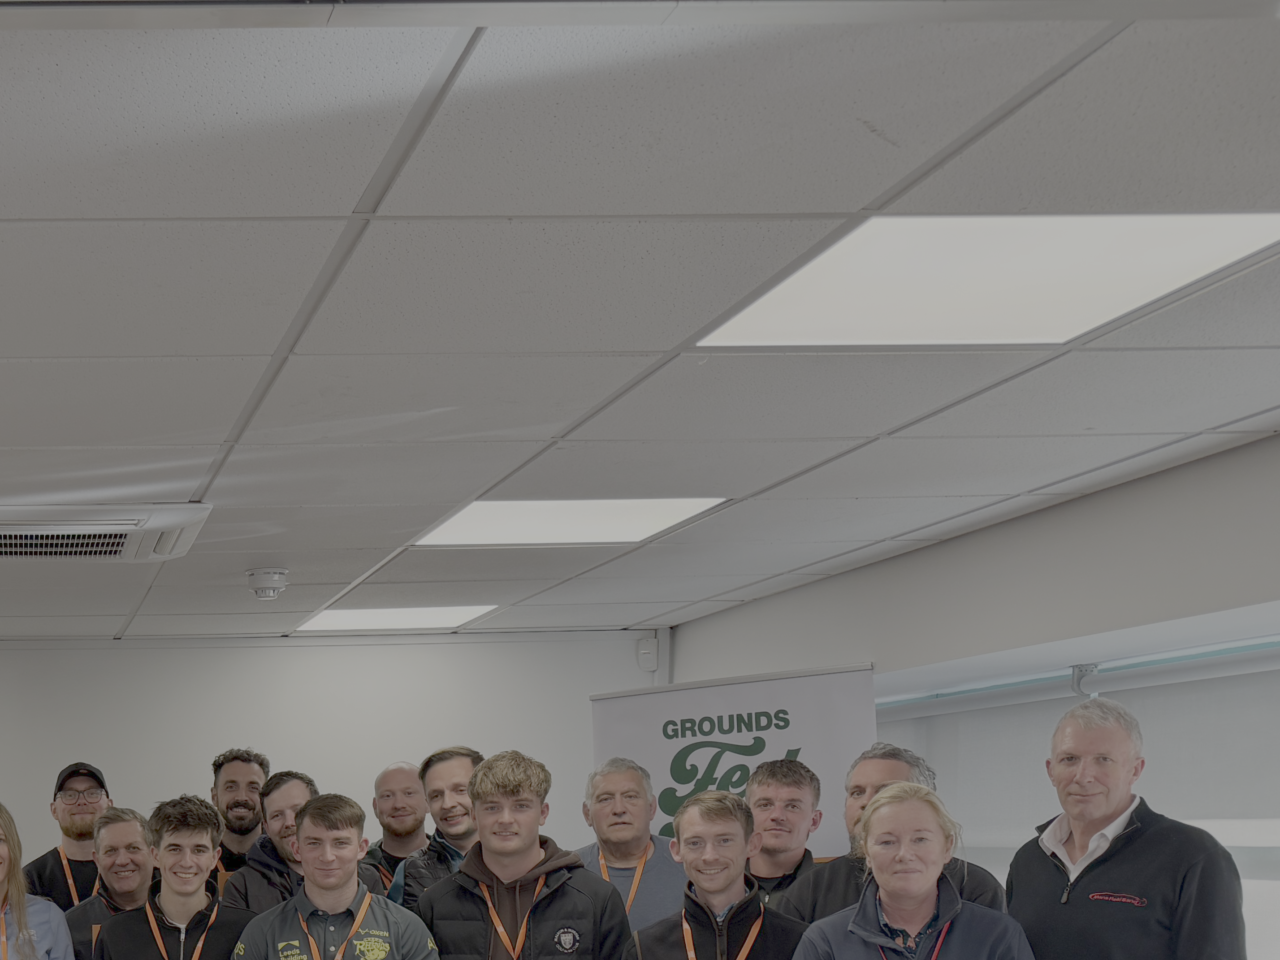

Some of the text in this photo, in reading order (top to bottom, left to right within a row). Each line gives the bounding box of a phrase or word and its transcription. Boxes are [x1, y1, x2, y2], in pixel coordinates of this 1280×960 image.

[662, 709, 790, 740] GROUNDS
[658, 736, 802, 817] Fe
[279, 948, 300, 957] Leeds
